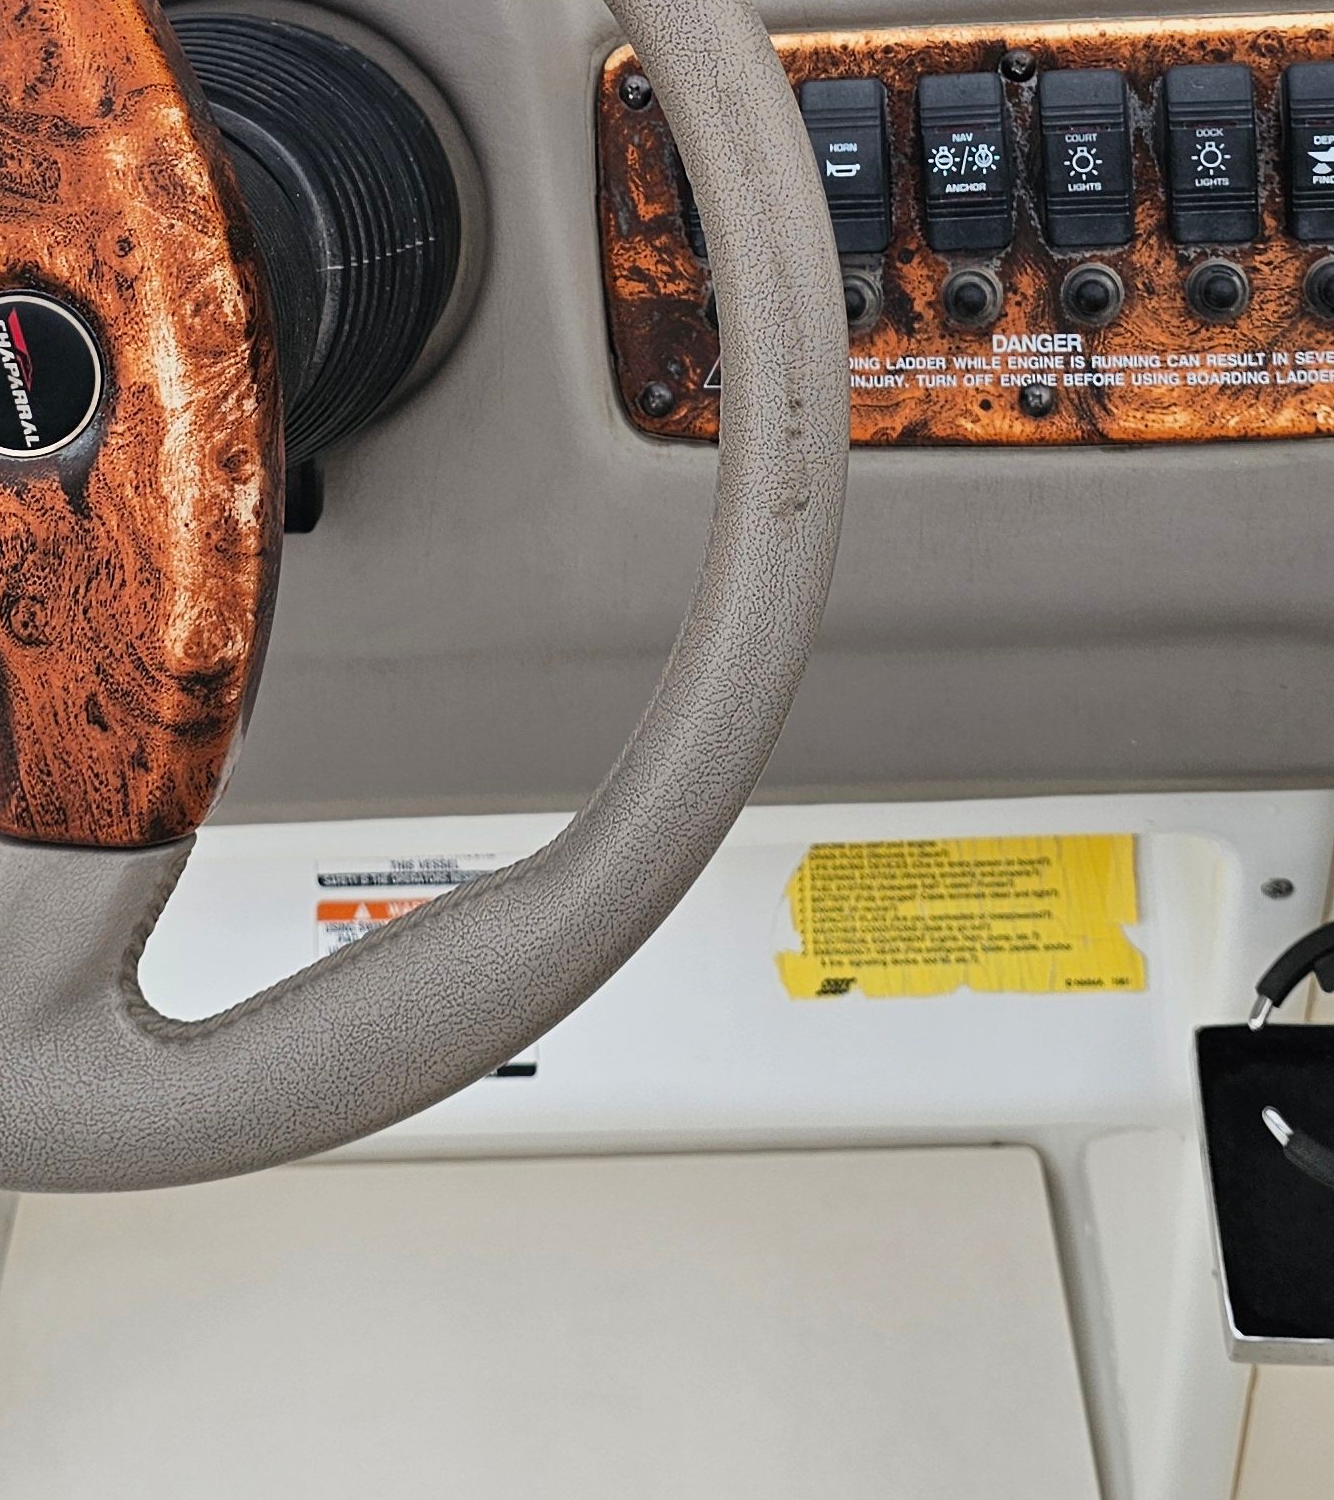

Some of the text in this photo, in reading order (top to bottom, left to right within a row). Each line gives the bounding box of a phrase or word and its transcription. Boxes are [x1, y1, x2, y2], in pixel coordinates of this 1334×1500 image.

[1196, 128, 1223, 137] DOCK
[952, 133, 973, 143] NAV
[1065, 133, 1097, 143] COURT
[829, 143, 857, 153] HORN
[1067, 181, 1101, 192] LIGHTS
[1195, 177, 1229, 187] LIGHTS
[945, 183, 987, 193] ANCHOR
[992, 334, 1082, 353] DANGER
[885, 357, 946, 370] LADDER
[953, 356, 1001, 369] WHILE
[1008, 356, 1064, 369] ENGINE
[1071, 356, 1085, 369] IS
[1091, 355, 1160, 369] RUNNING
[1167, 354, 1199, 367] CAN
[1207, 353, 1266, 367] RESULT
[1272, 352, 1288, 365] IN
[917, 374, 957, 388] TURN
[963, 374, 993, 387] OFF
[1000, 373, 1057, 387] ENGINE
[1063, 373, 1124, 387] BEFORE
[1131, 373, 1179, 386] USING
[1187, 371, 1270, 386] BOARDING
